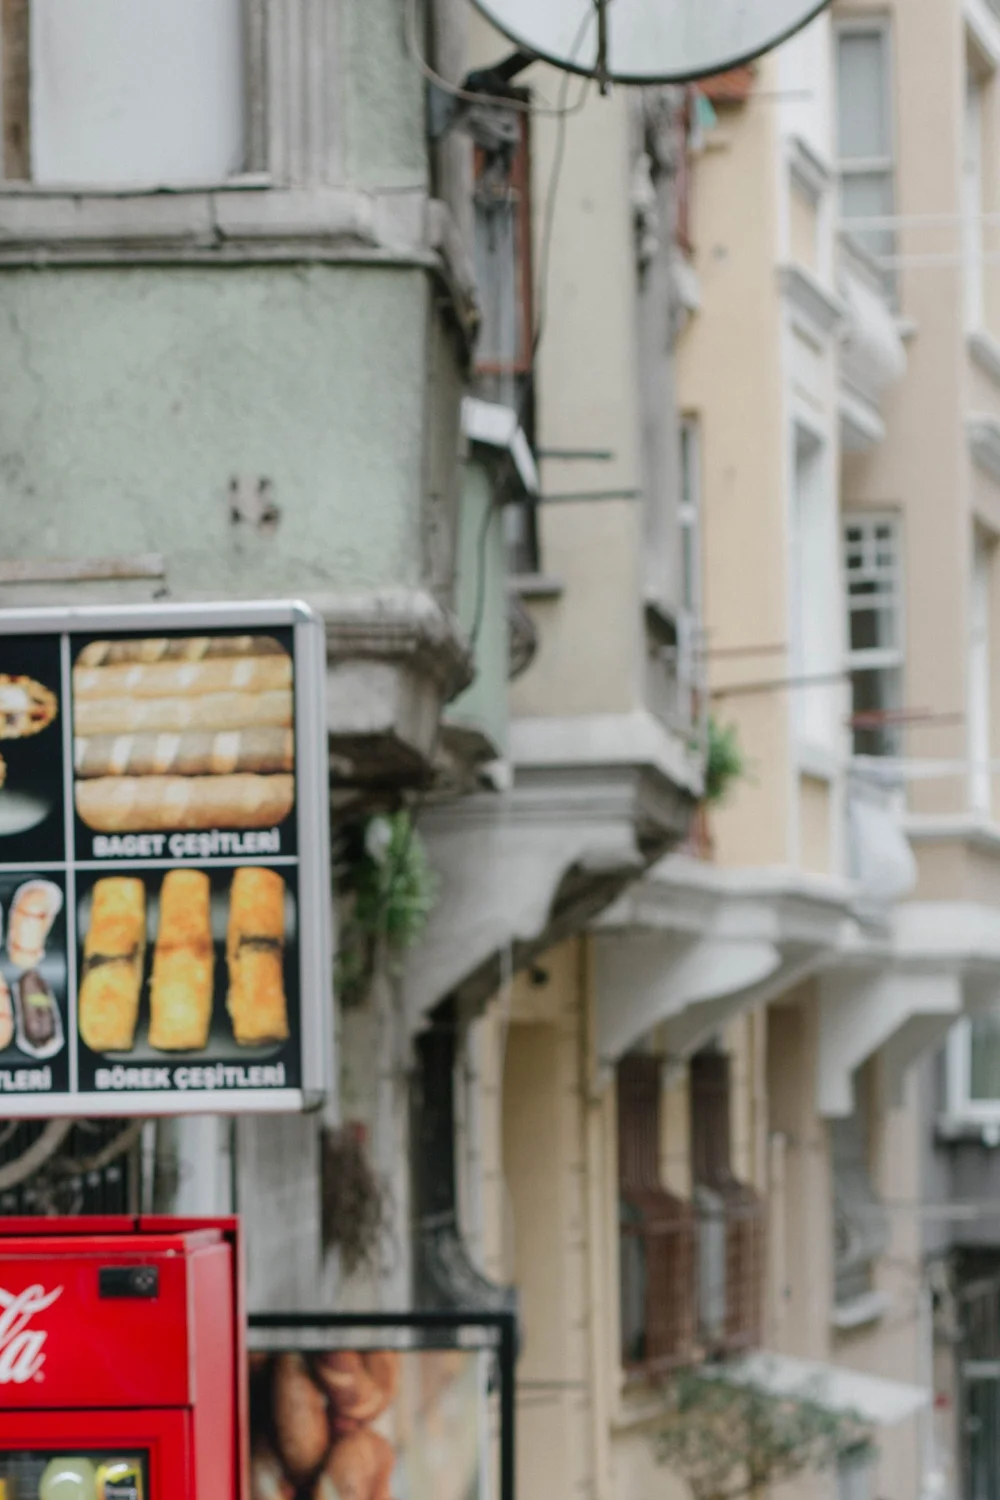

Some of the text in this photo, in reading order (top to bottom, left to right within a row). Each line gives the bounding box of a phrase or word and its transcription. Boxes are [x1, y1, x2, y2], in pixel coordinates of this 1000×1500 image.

[92, 827, 281, 858] BAGET ÇEŞİTLERİ
[94, 1061, 286, 1090] BÖREK ÇEŞİTLERİ
